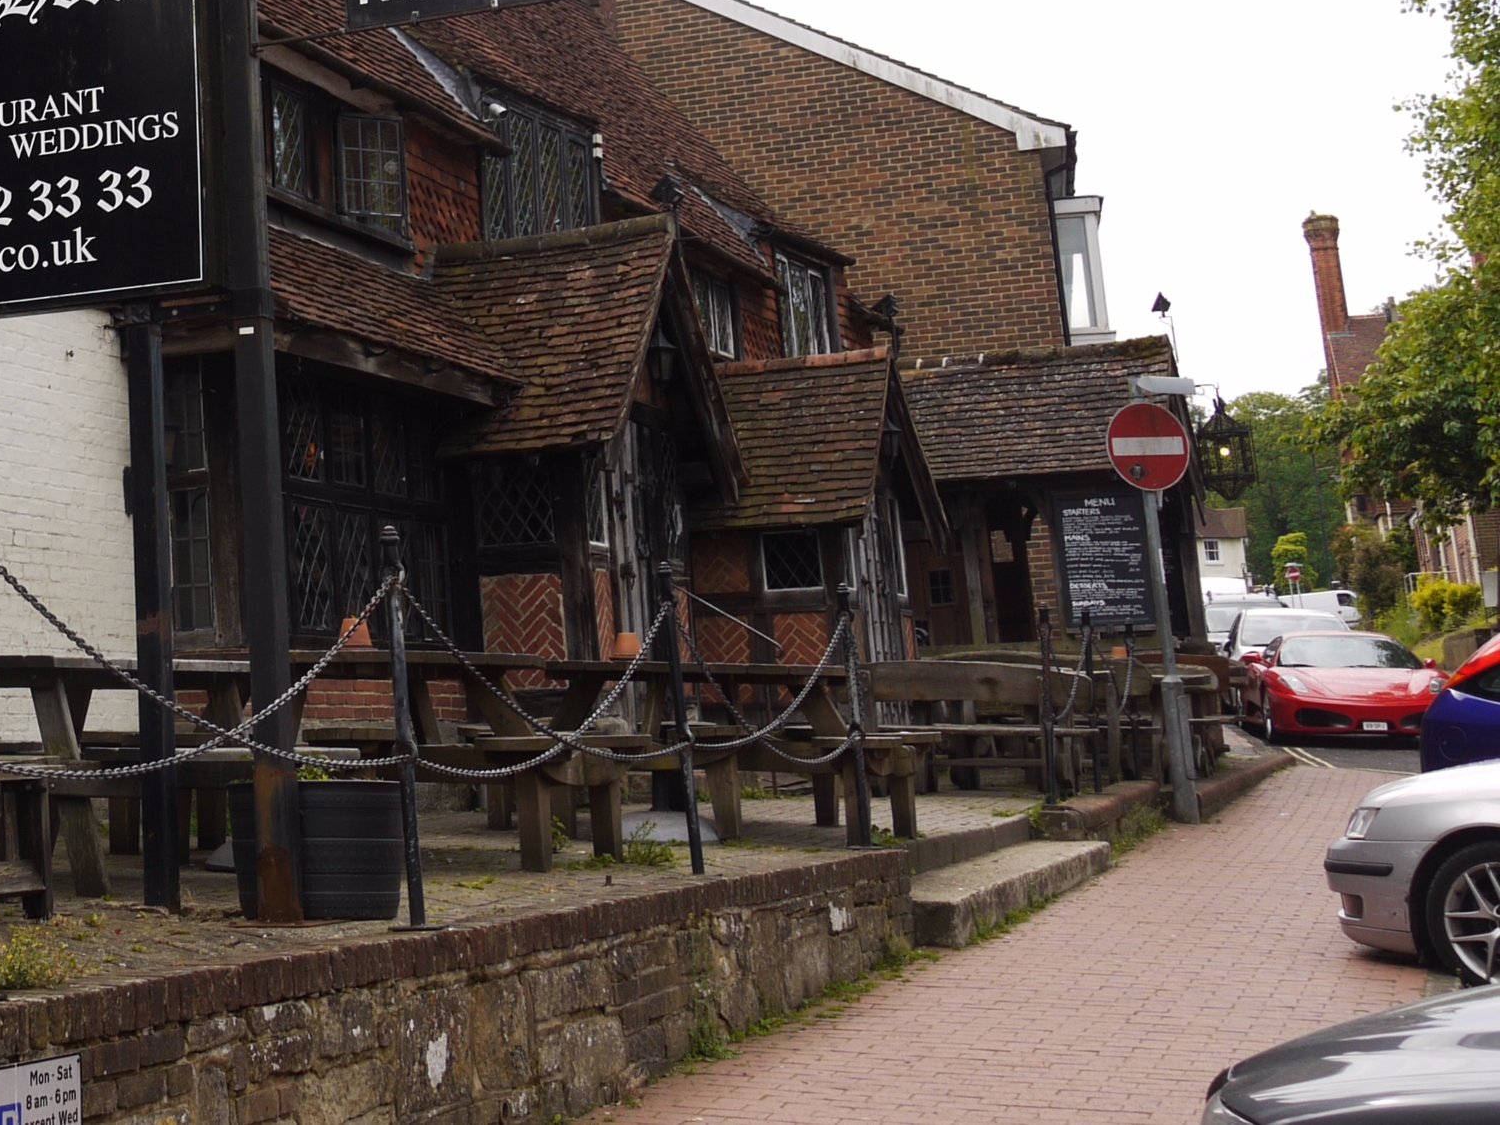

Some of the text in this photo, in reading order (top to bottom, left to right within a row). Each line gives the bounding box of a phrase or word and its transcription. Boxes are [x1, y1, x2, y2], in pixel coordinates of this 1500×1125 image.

[9, 112, 179, 159] WEDDINGS
[28, 175, 81, 221] 33
[97, 166, 152, 212] 33
[1084, 498, 1115, 507] MENU
[1062, 508, 1100, 516] STARTERS
[1064, 534, 1090, 542] MAINS
[30, 1070, 50, 1086] Mon
[57, 1064, 73, 1081] Sat
[59, 1108, 79, 1125] Wed
